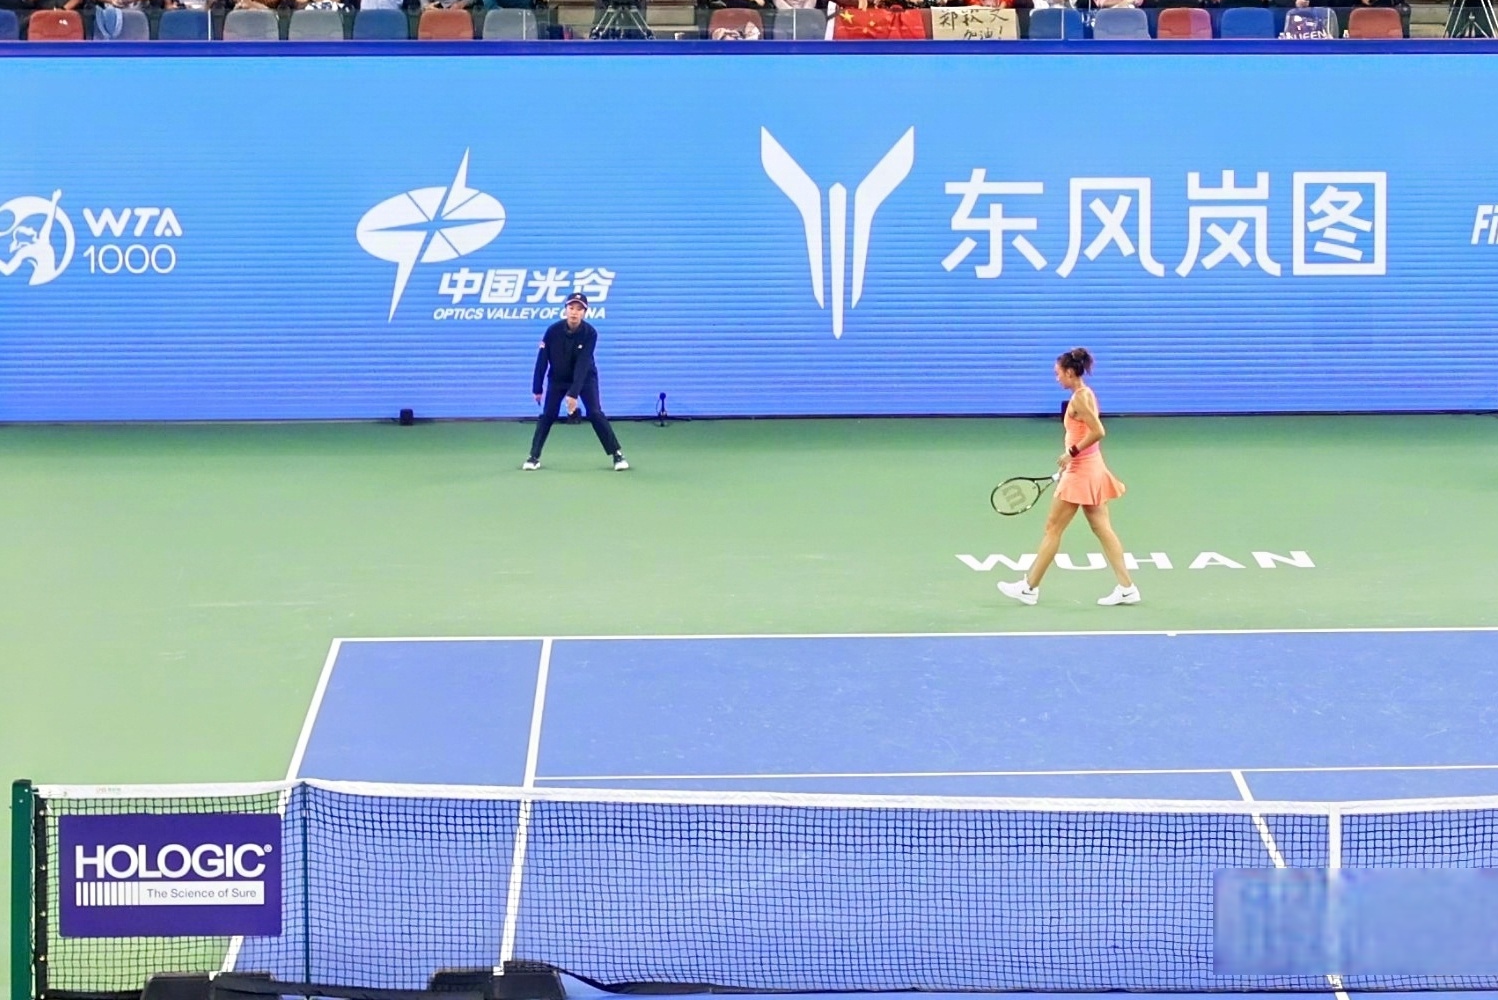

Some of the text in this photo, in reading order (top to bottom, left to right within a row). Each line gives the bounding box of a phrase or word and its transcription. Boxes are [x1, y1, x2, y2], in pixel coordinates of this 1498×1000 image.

[82, 207, 183, 237] WTA
[941, 168, 1387, 279] 东风岚图
[83, 243, 177, 274] 1000
[438, 267, 616, 305] 中国光谷
[433, 307, 607, 320] OPTICS VALLEY OF CNA
[954, 550, 1316, 572] WUHAN
[75, 843, 267, 880] HOLOGIC
[146, 887, 257, 899] The Science of Sure
